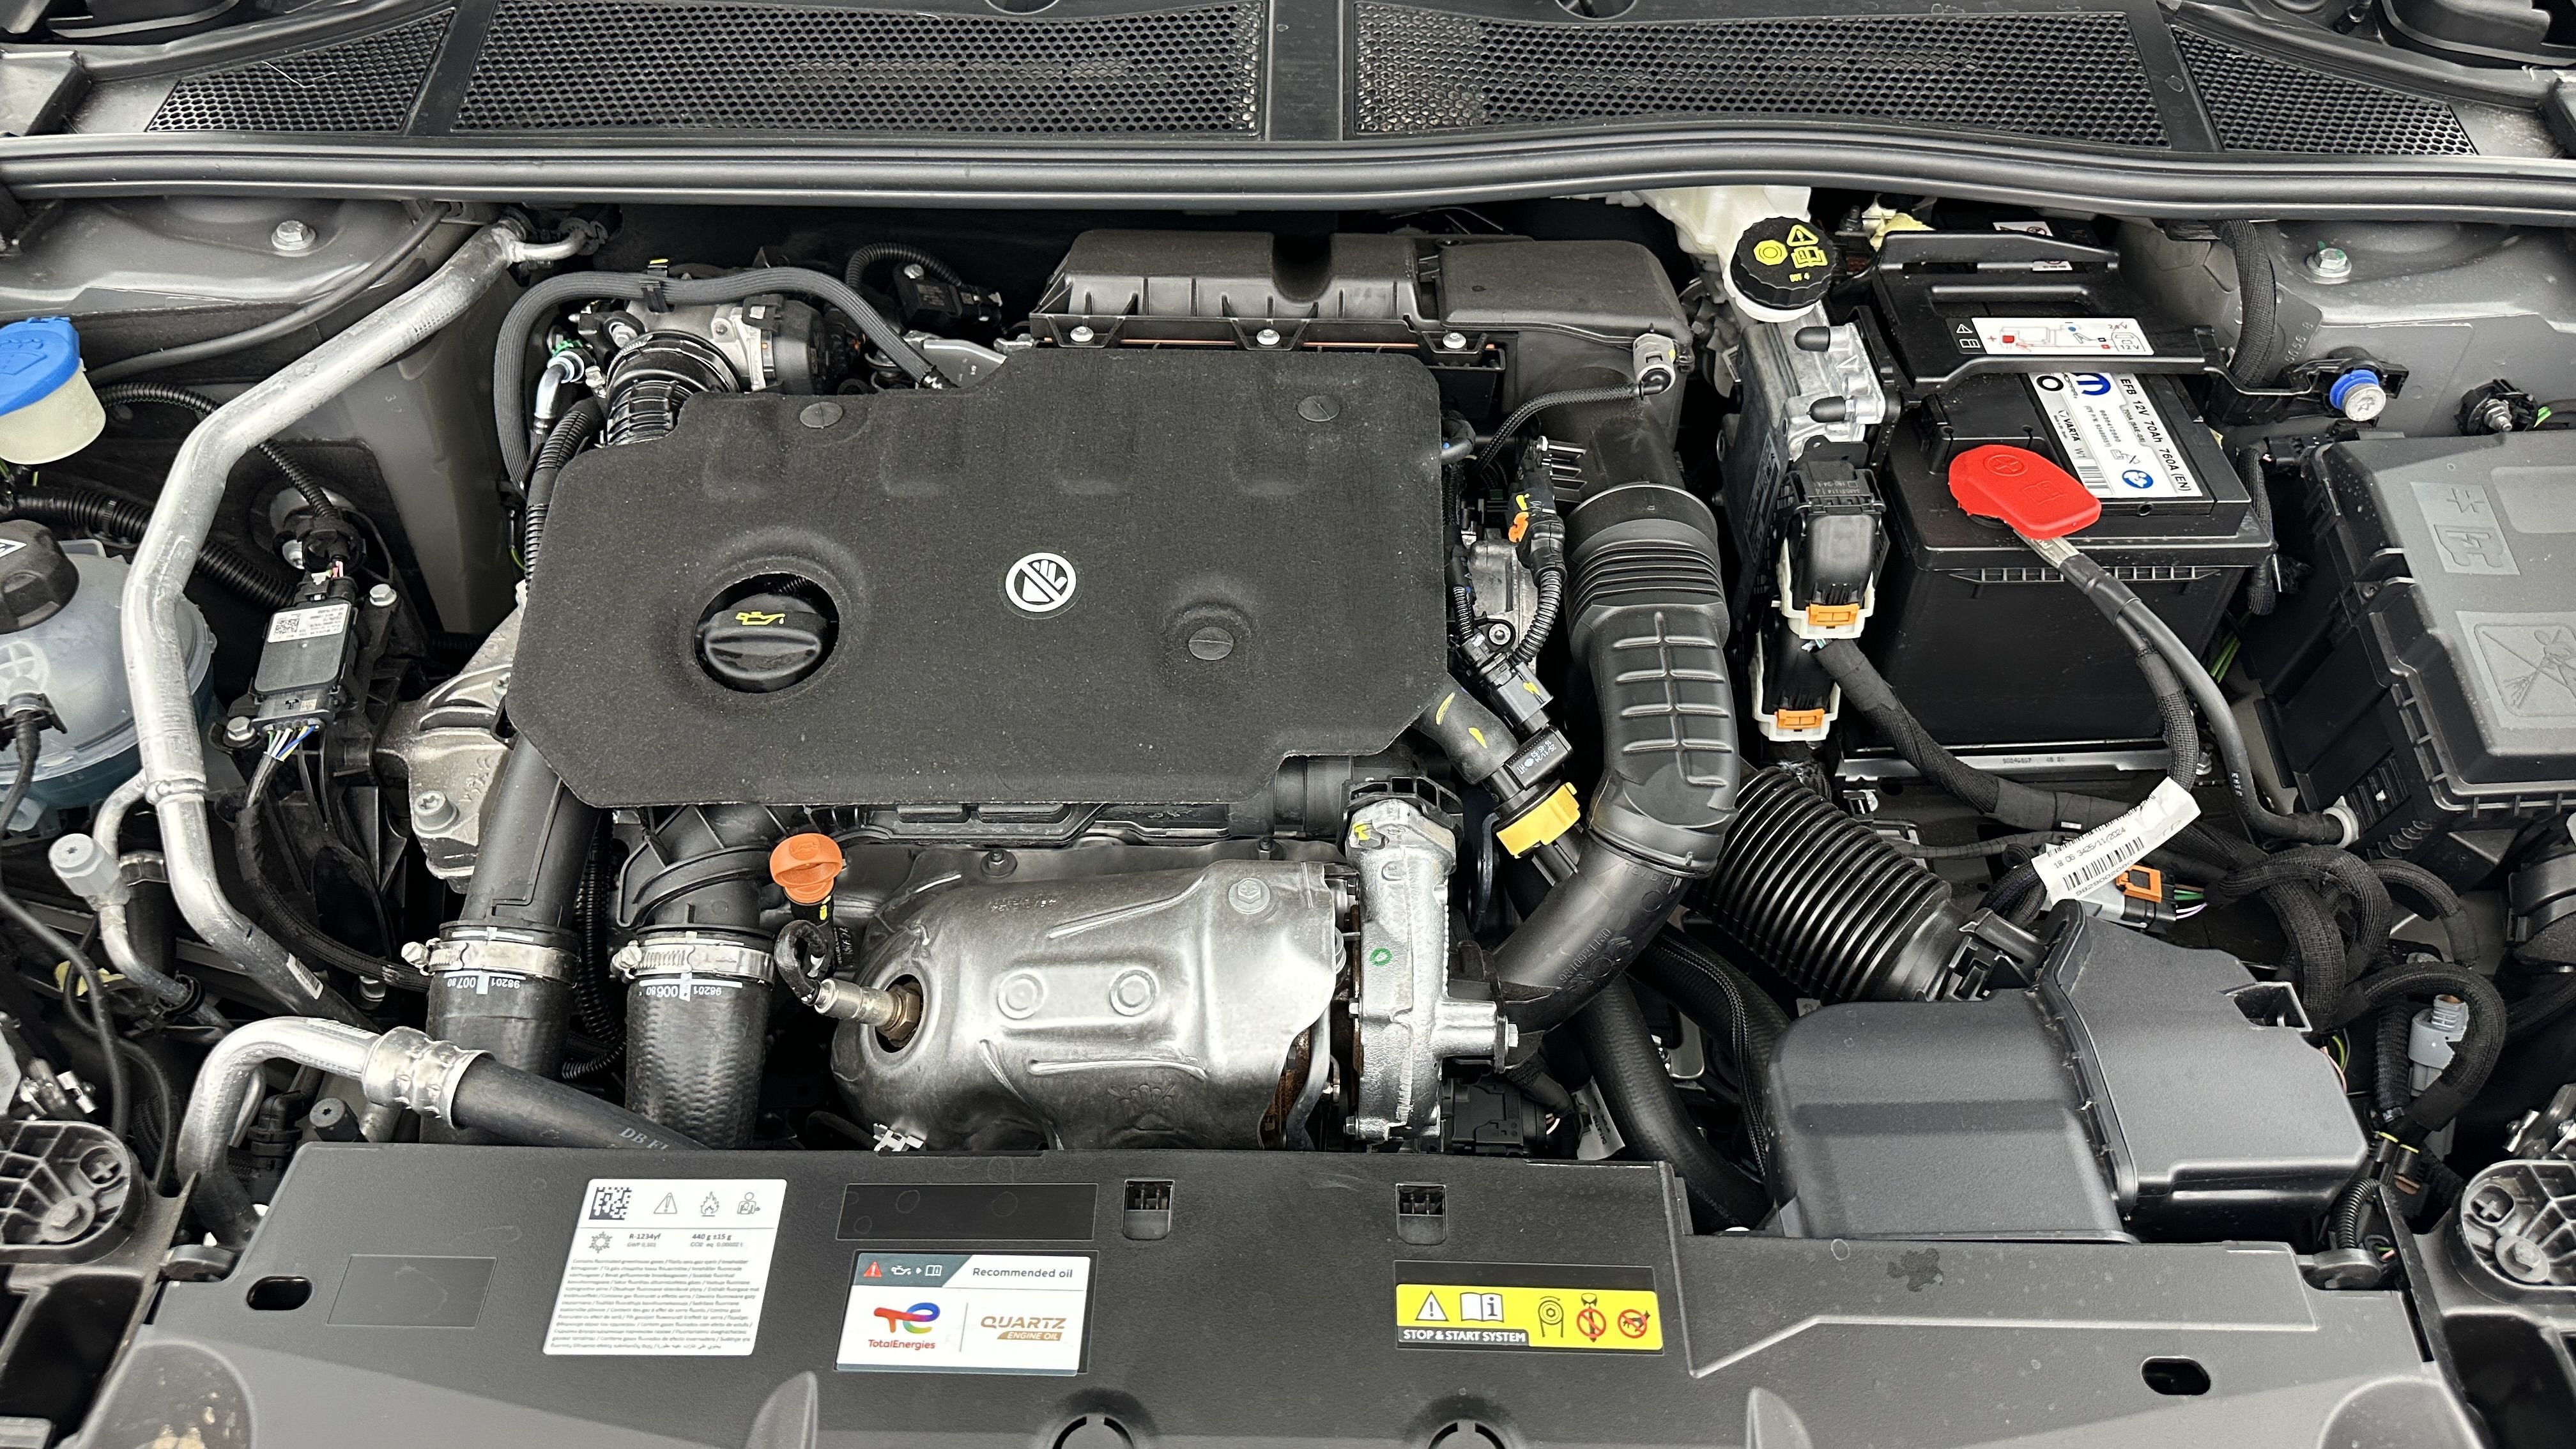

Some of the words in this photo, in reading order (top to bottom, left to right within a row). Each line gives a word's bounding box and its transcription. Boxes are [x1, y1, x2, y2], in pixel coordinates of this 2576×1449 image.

[2063, 418, 2081, 442] VARTA
[2120, 378, 2138, 395] EFB
[2133, 400, 2150, 416] 12V
[2144, 420, 2163, 443] 70Ah
[2159, 448, 2180, 471] 760A
[2171, 473, 2191, 492] (EN)
[491, 977, 521, 990] 98201
[693, 985, 723, 997] 98201
[618, 1128, 645, 1145] DB
[972, 1268, 1055, 1278] Recommended
[1059, 1268, 1073, 1278] oil
[980, 1315, 1067, 1330] QUARTZ
[1007, 1331, 1043, 1340] ENGINE
[1044, 1332, 1059, 1340] OIL
[1404, 1329, 1435, 1340] STOP
[1435, 1330, 1444, 1341] &
[1445, 1330, 1480, 1342] START
[1483, 1331, 1526, 1343] SYSTEM
[868, 1339, 936, 1351] TotalEnergies
